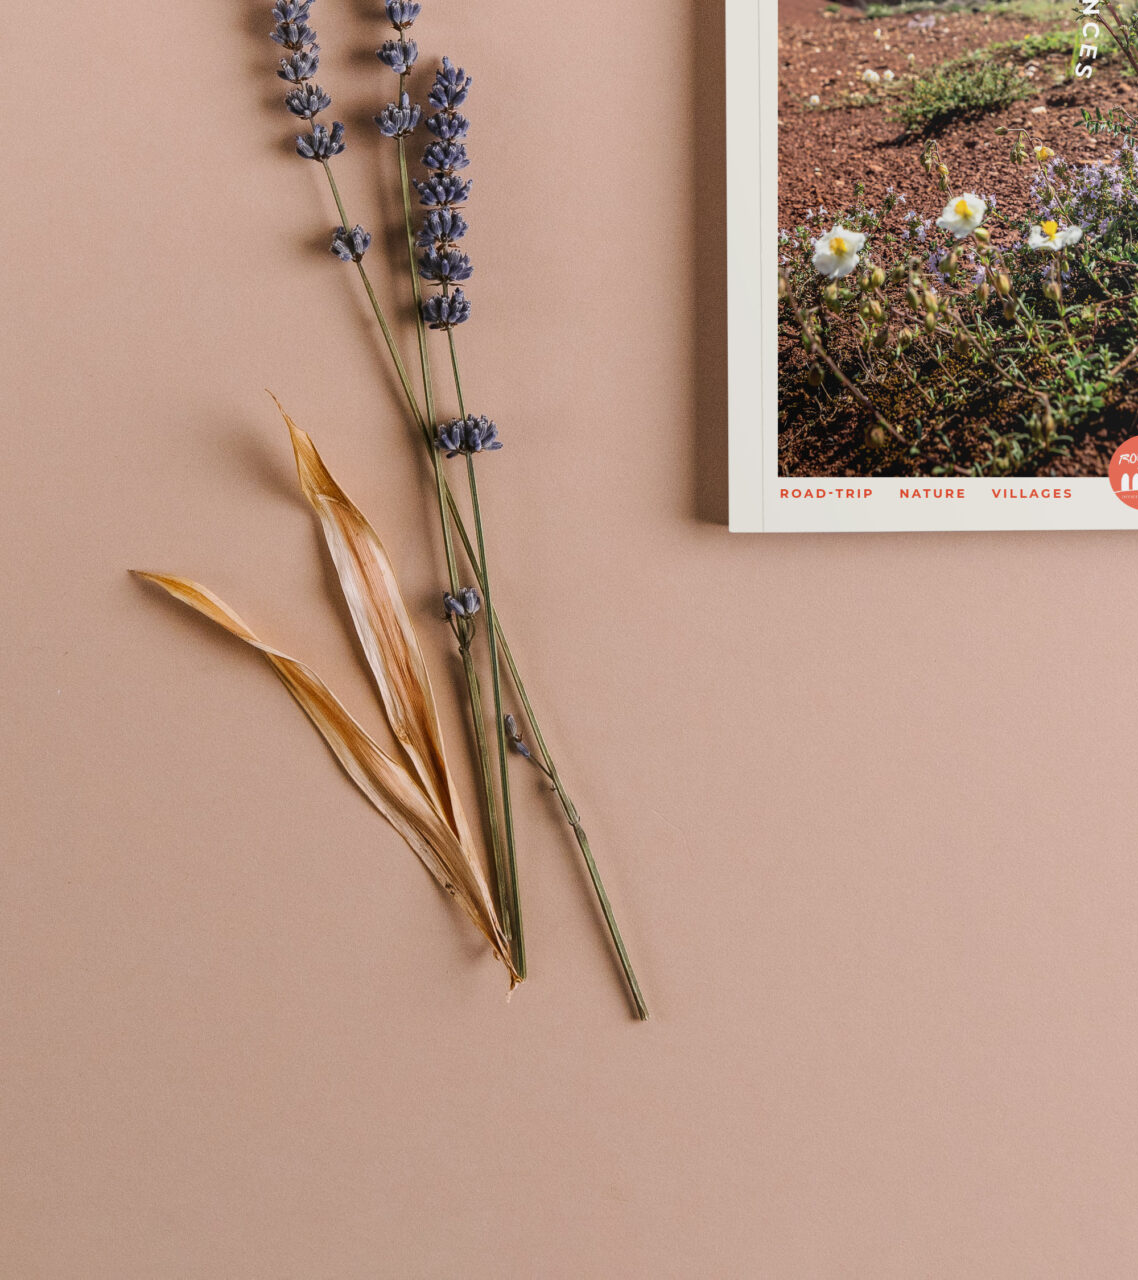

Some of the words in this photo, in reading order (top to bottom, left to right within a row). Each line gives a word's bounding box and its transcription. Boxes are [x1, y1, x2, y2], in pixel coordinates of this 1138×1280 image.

[779, 488, 873, 500] ROAD-TRIP
[899, 487, 966, 500] NATURE
[991, 487, 1073, 500] VILLAGES
